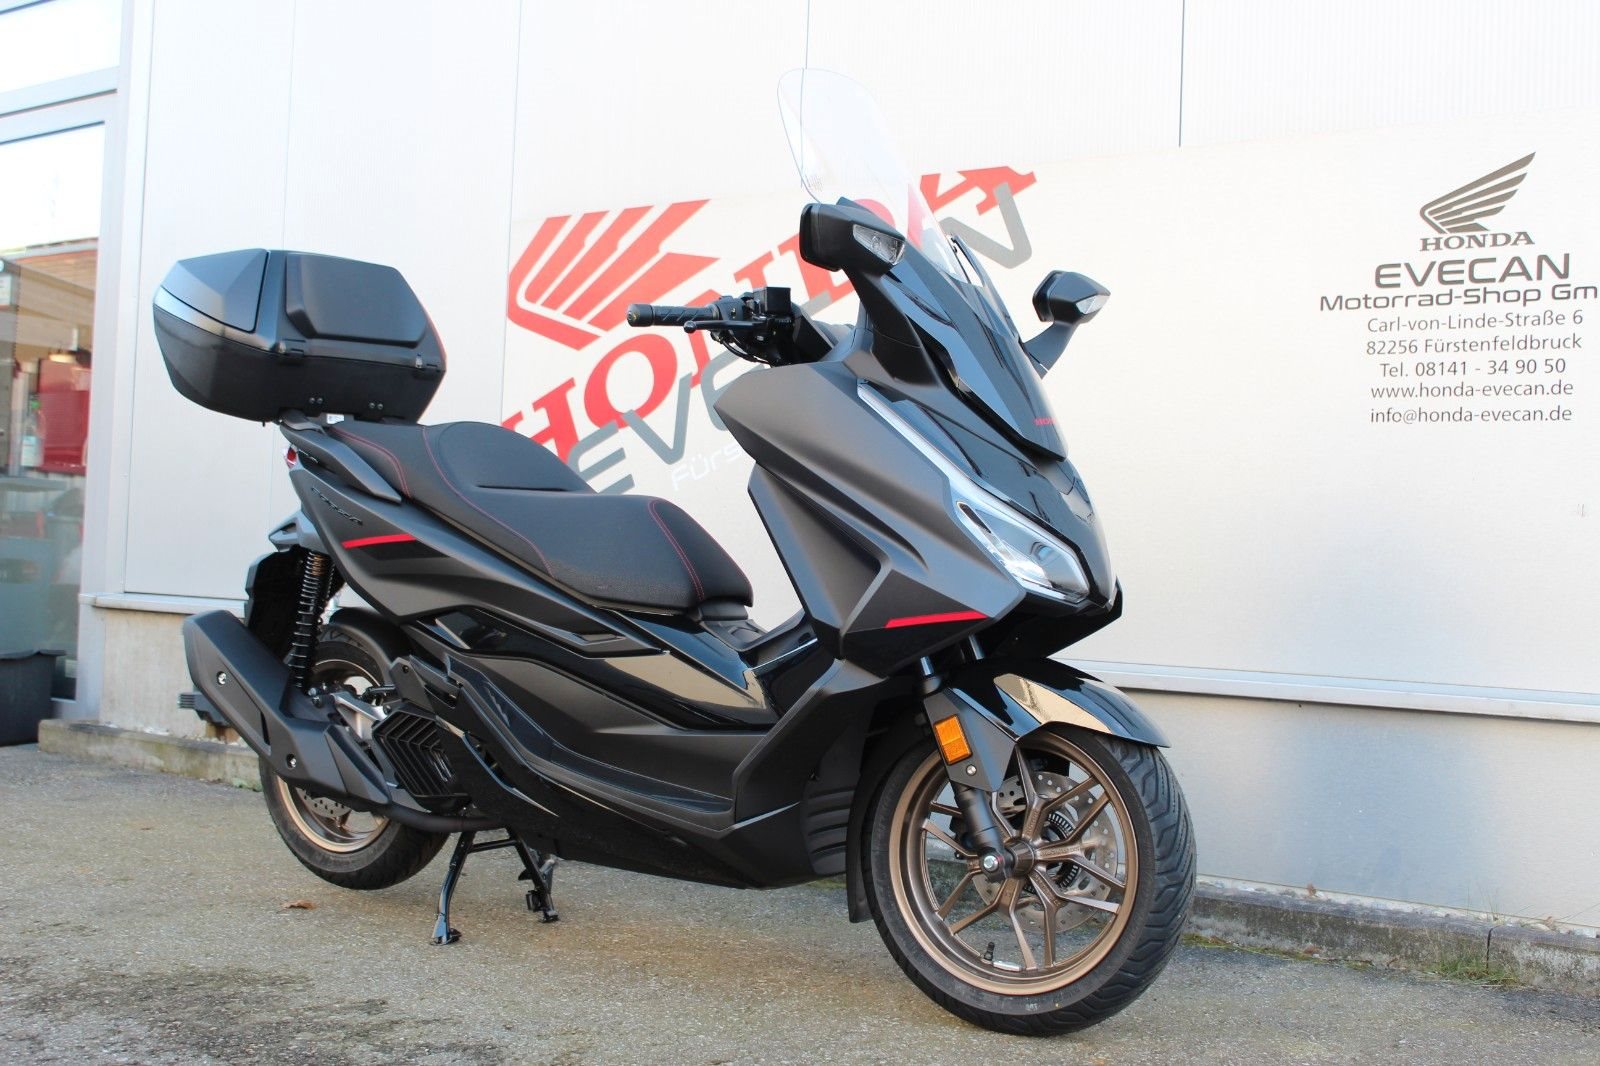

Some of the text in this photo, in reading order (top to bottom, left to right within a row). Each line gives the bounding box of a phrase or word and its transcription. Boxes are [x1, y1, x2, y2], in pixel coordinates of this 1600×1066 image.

[1419, 231, 1536, 252] HONDA
[1375, 253, 1571, 289] EVECAN
[1320, 283, 1598, 312] Motorrad-Shop Gm
[1367, 309, 1584, 333] Carl-von-Linde-Straße 6
[1366, 333, 1582, 356] 82256 Fürstenfeldbruck
[1379, 362, 1409, 378] Tel.
[1415, 360, 1467, 377] 08141
[1487, 359, 1509, 376] 34
[1515, 358, 1538, 375] 90
[1544, 357, 1567, 374] 50
[1370, 379, 1574, 399] www.honda-evecan.de
[1370, 405, 1573, 425] info@honda-evecan.de
